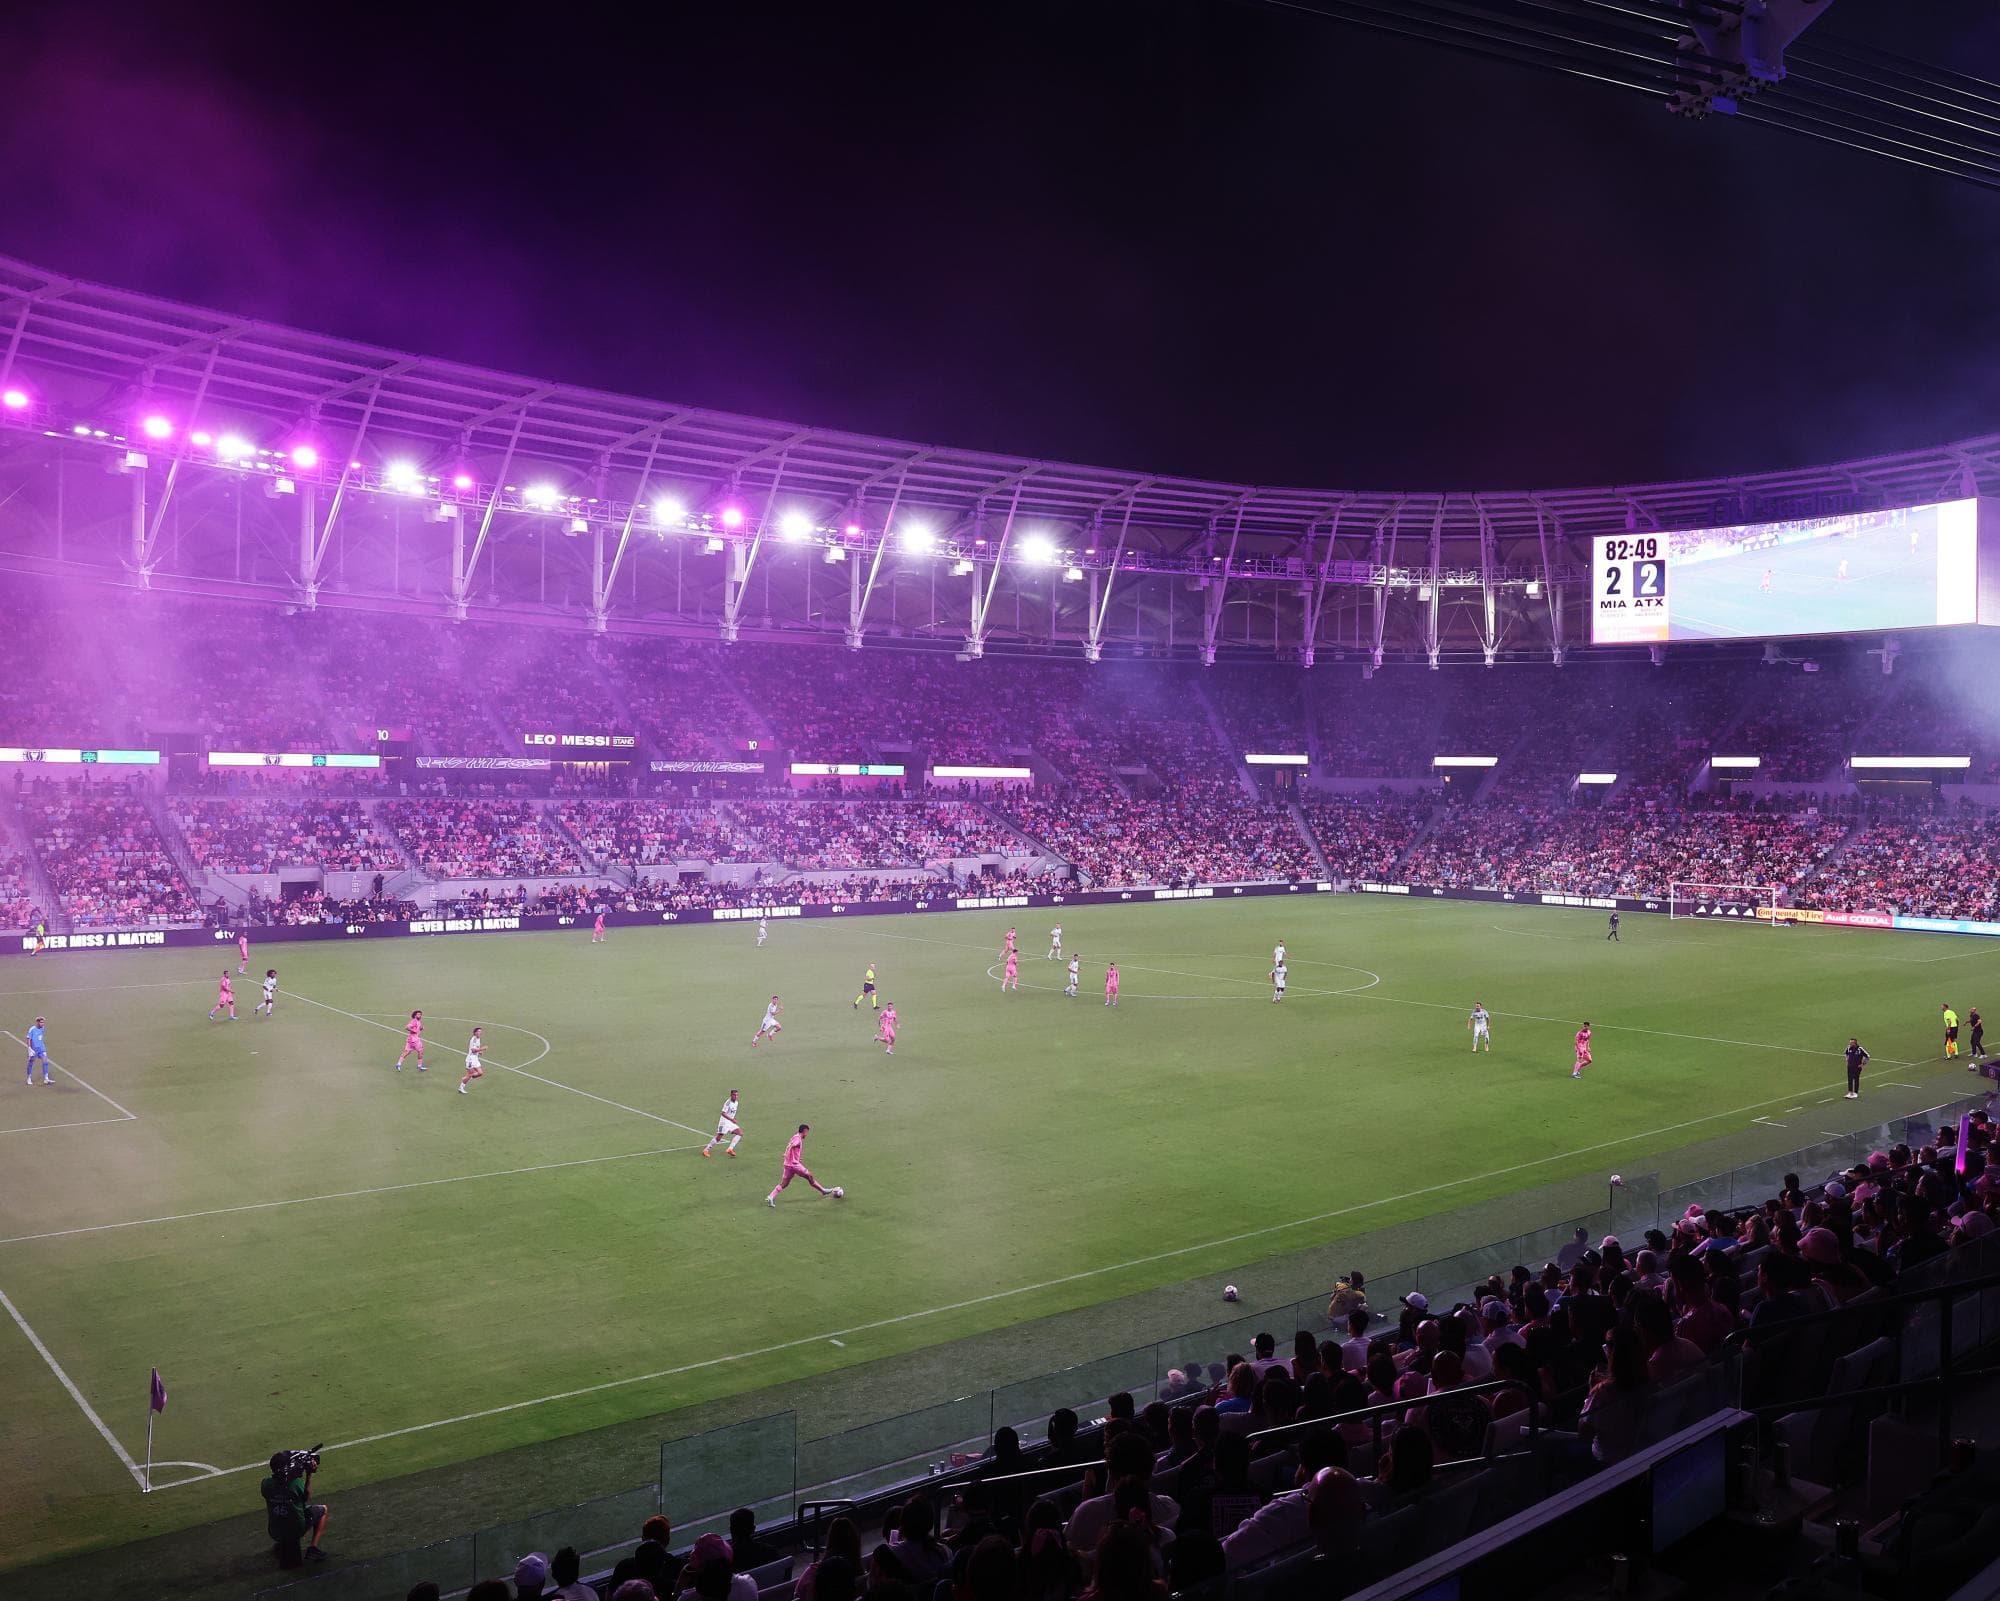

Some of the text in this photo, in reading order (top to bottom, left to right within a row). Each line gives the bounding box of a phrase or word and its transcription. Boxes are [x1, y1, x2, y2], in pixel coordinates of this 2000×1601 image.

[1606, 538, 1657, 560] 82:49
[1606, 563, 1658, 595] 2 2
[1600, 598, 1664, 609] MIA ATX
[377, 730, 389, 741] 10
[524, 734, 635, 746] LEO MESSI STAND
[748, 741, 758, 751] 10
[957, 898, 979, 909] NEVER
[980, 898, 998, 907] MISS
[999, 898, 1004, 906] A
[713, 906, 801, 919] NEVER MISS A MATCH
[1825, 913, 1847, 922] Audi
[410, 917, 519, 932] NEVER MISS A MATCH
[70, 935, 104, 947] MISS
[107, 934, 116, 945] A
[118, 932, 164, 946] MATCH
